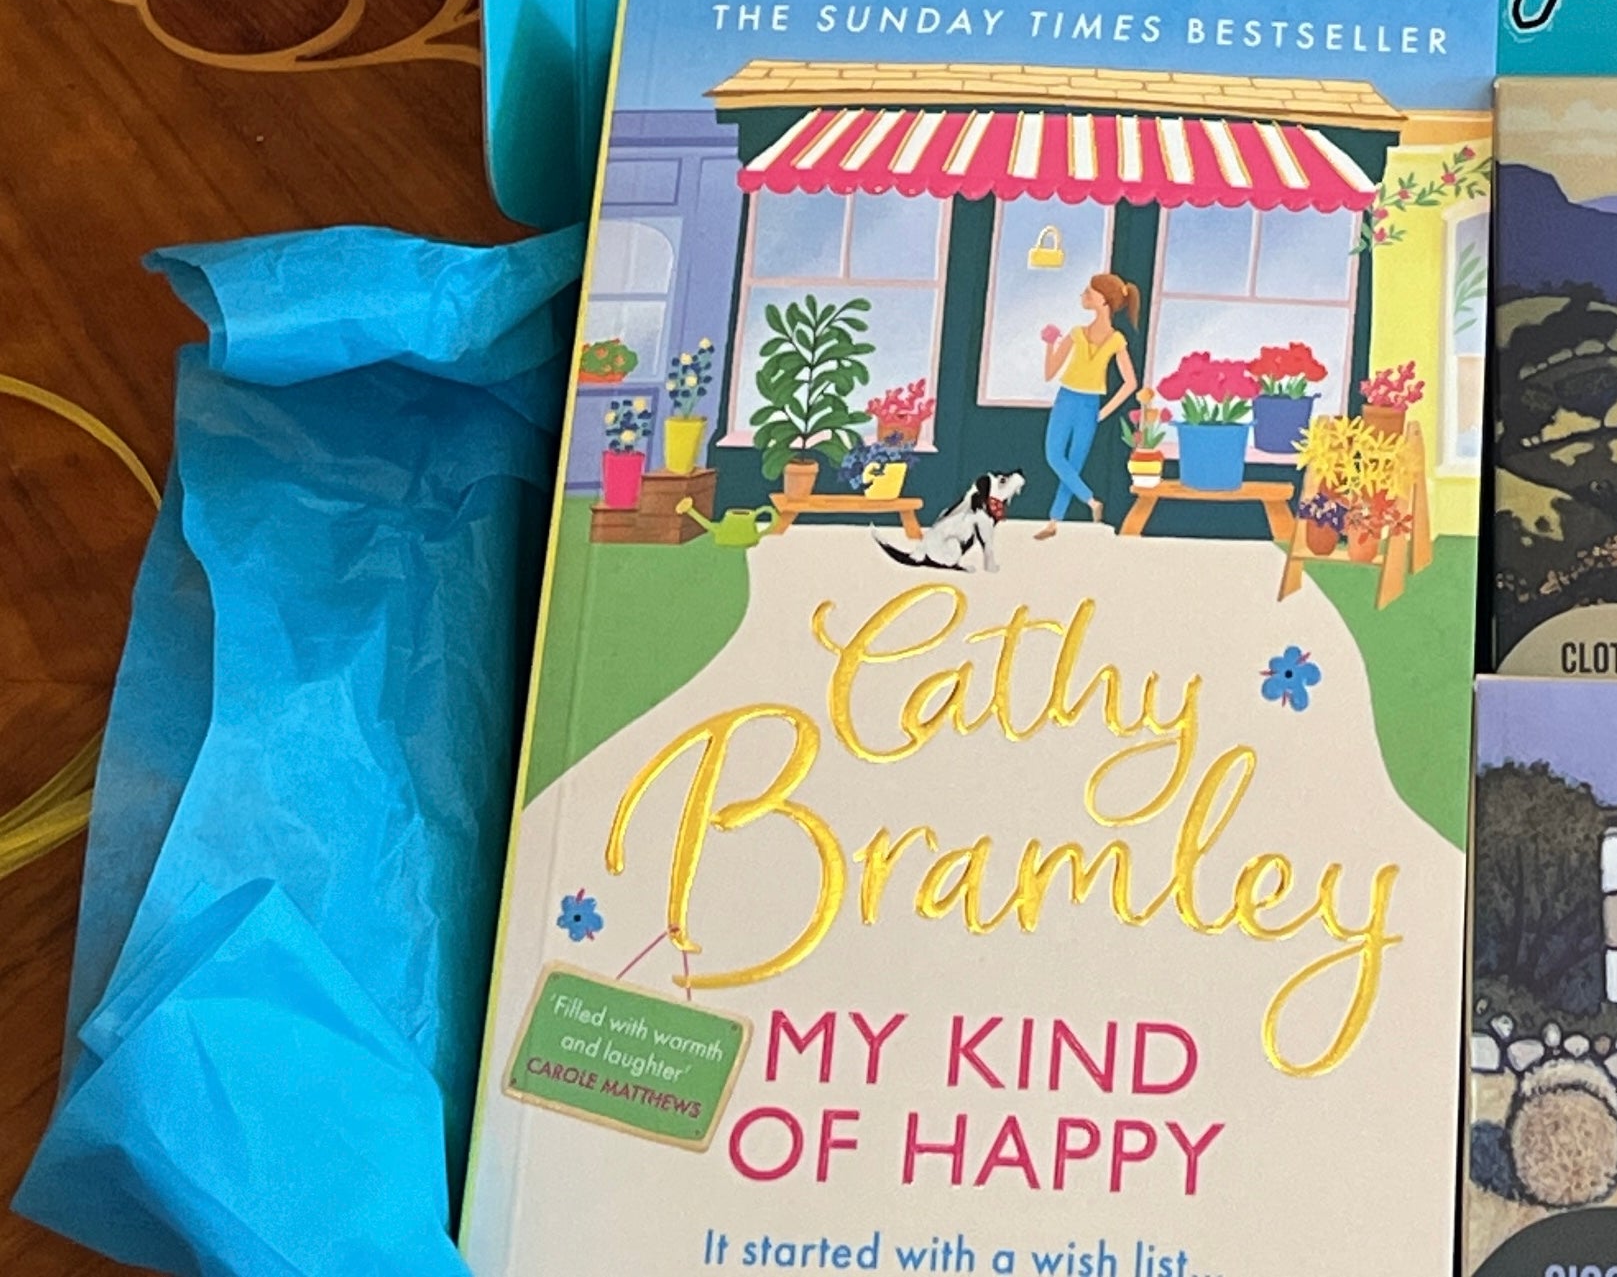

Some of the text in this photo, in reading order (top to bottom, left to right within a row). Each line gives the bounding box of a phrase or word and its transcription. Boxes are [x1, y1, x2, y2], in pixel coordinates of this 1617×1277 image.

[712, 3, 1450, 56] THE SUNDAY TIMES BESTSELLER
[811, 581, 1202, 828] Cathy
[605, 702, 1402, 1078] Bramley
[561, 1034, 602, 1058] and
[609, 1017, 647, 1040] with
[654, 1029, 724, 1062] warmth
[764, 1009, 1200, 1097] MY KIND
[526, 1056, 702, 1119] CAROLE MATTHEWS
[727, 1107, 1226, 1197] OF HAPPY
[704, 1229, 728, 1264] It
[742, 1231, 881, 1270] started
[895, 1234, 975, 1274] with
[992, 1250, 1016, 1276] a
[1031, 1239, 1117, 1277] wish
